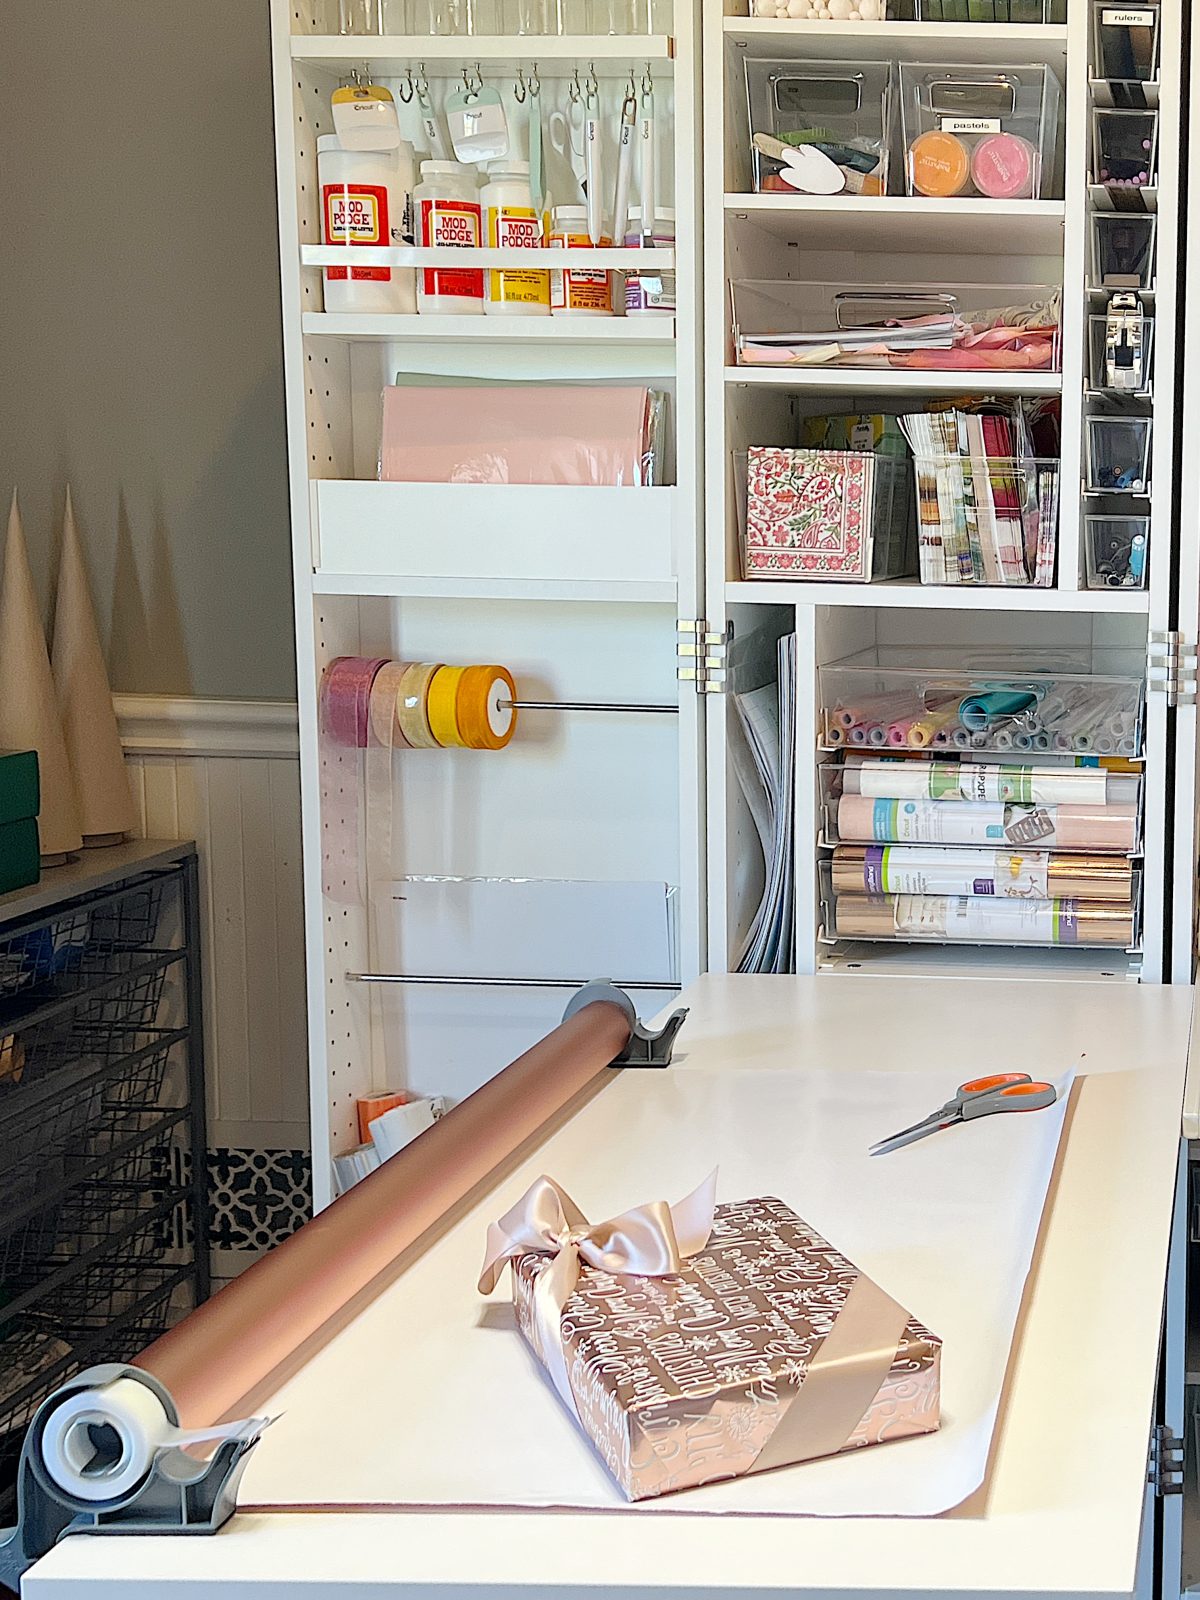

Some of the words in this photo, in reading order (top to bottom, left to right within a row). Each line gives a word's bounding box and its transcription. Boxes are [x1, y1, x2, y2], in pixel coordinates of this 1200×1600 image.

[1114, 14, 1143, 22] rulers
[953, 122, 990, 130] pastels
[338, 201, 363, 213] MOD
[441, 216, 467, 230] MOD
[435, 228, 472, 243] PODGE
[507, 223, 534, 237] MOD
[501, 236, 538, 248] PODGE
